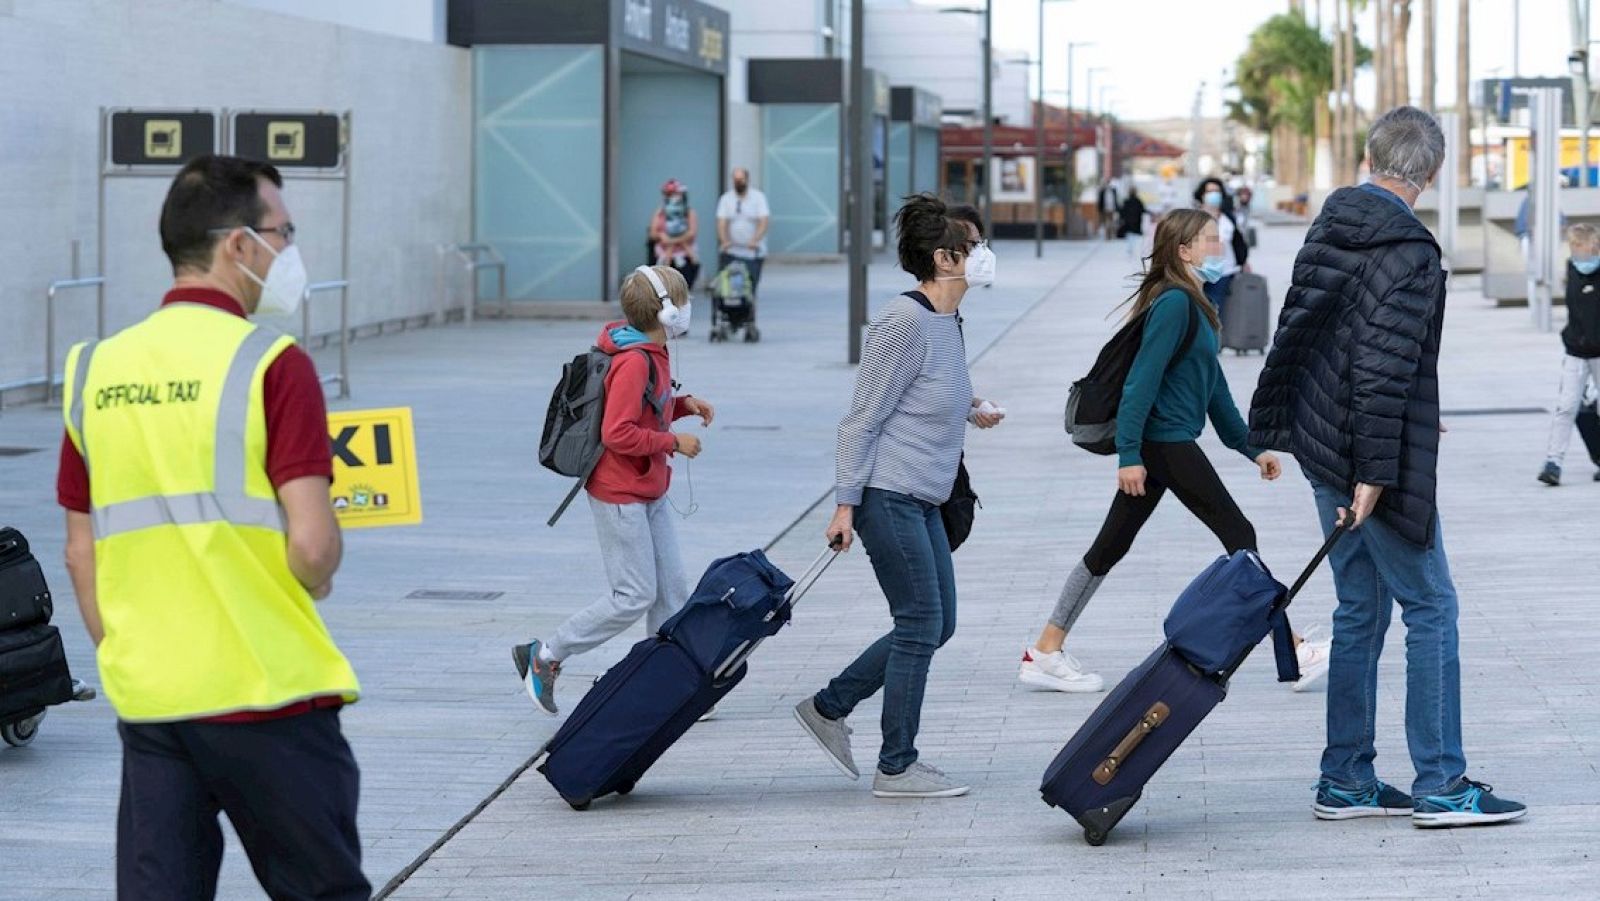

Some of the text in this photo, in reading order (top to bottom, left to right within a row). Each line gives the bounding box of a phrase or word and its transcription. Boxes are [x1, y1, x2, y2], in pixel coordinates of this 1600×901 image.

[95, 379, 202, 410] OFFICIAL TAXI
[328, 423, 393, 467] XI
